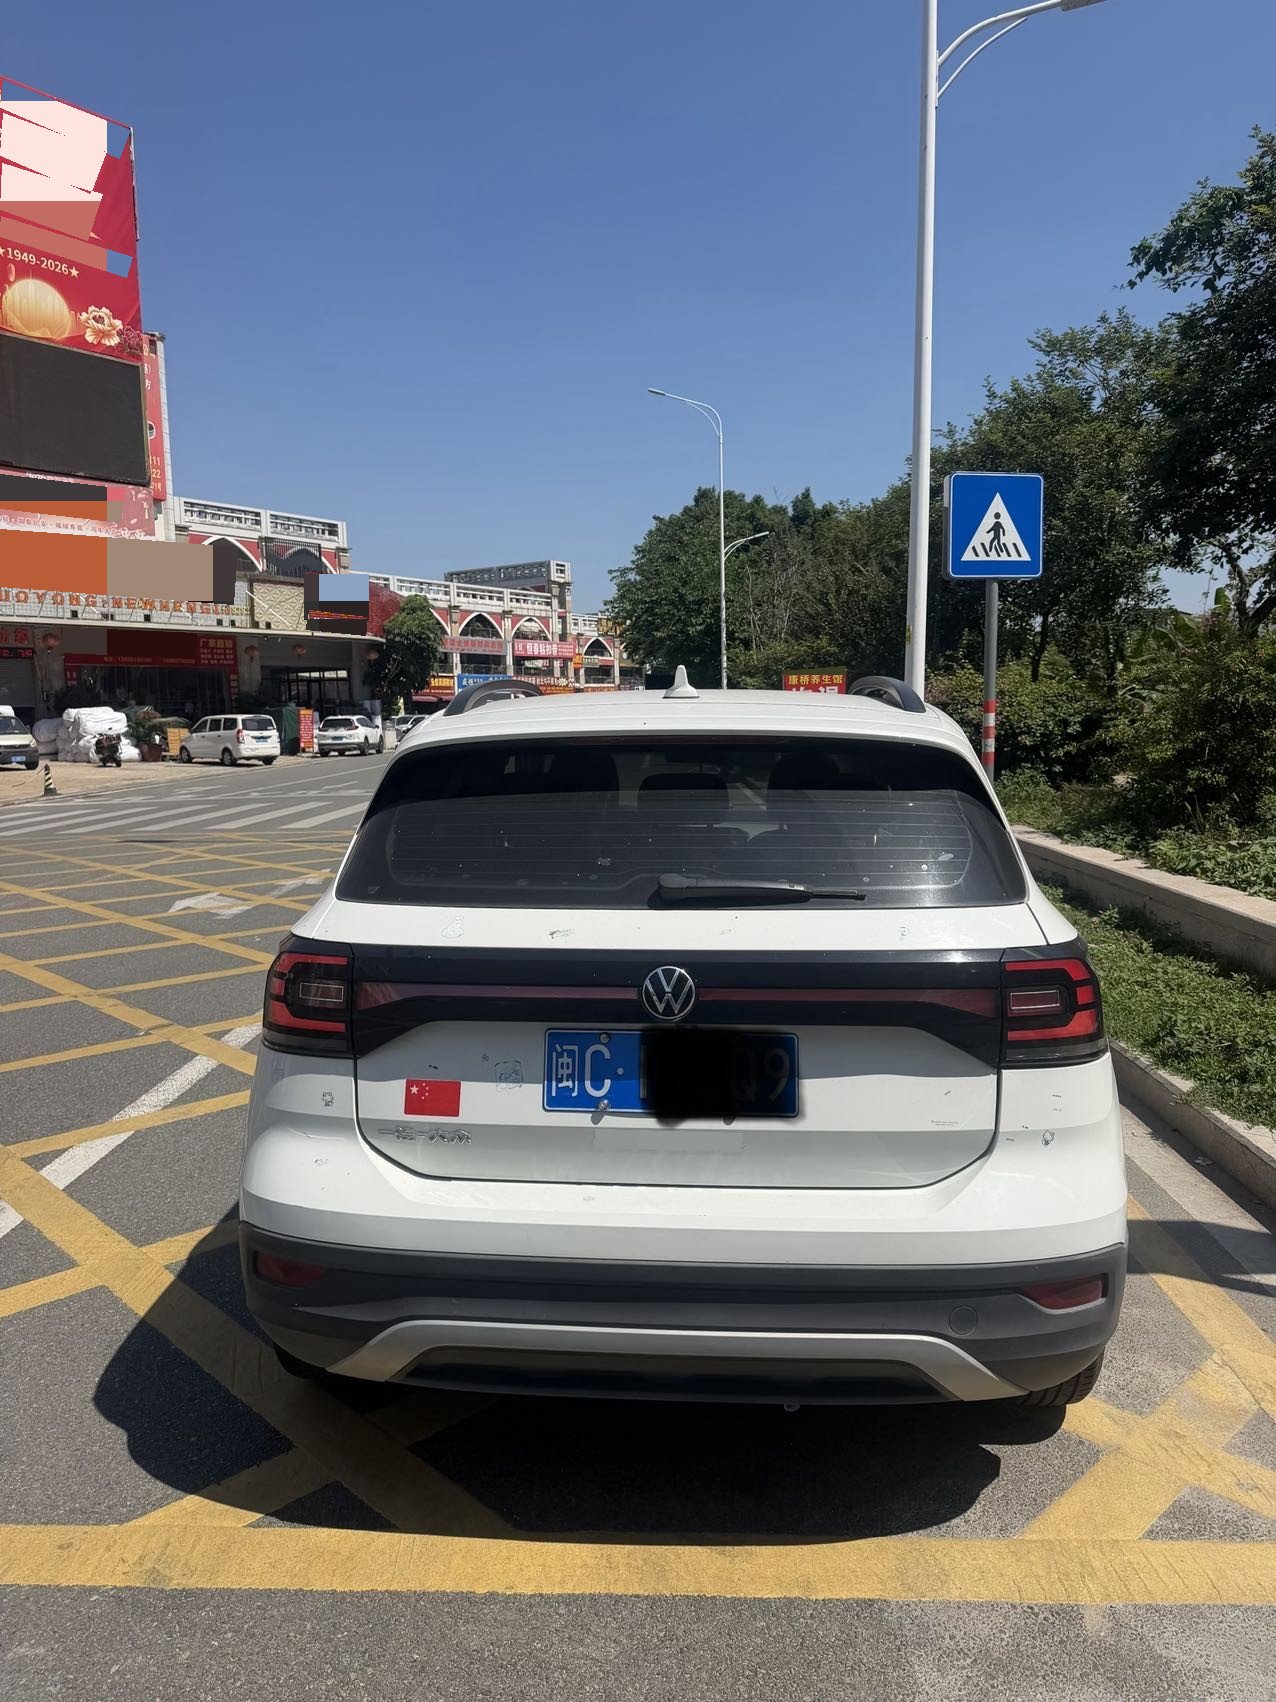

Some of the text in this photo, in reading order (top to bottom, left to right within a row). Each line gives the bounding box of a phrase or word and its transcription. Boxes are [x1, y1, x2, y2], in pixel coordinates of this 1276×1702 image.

[7, 247, 69, 275] 1949-2026
[788, 674, 843, 685] 康桥养生馆
